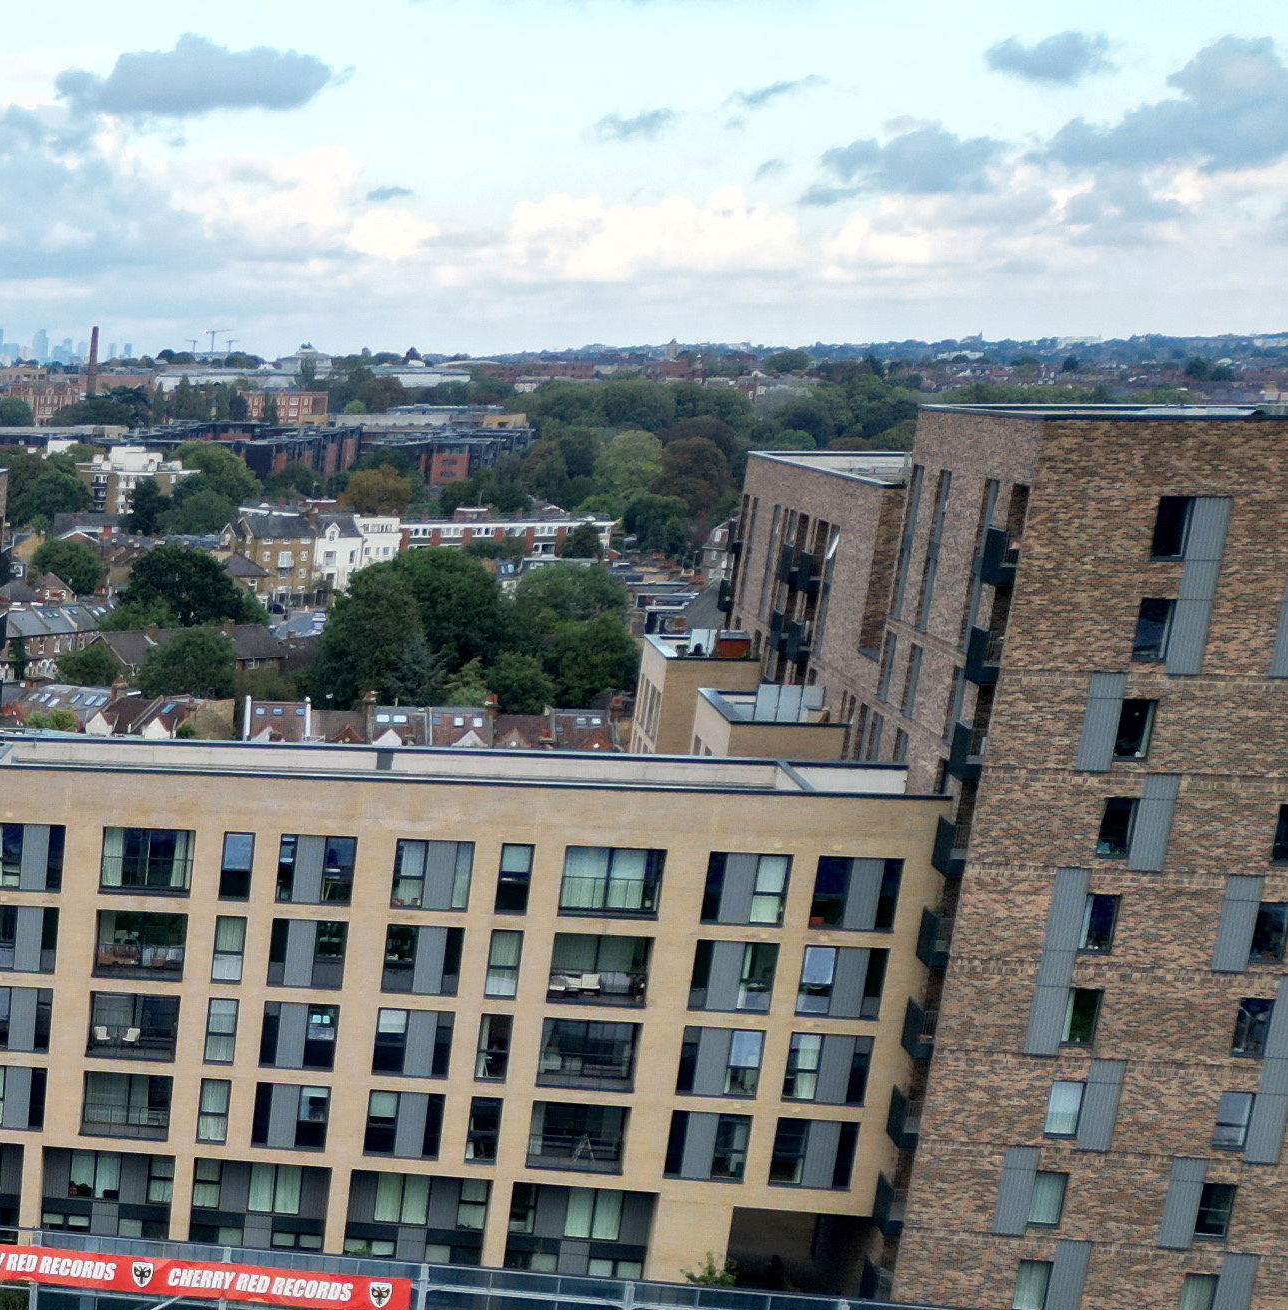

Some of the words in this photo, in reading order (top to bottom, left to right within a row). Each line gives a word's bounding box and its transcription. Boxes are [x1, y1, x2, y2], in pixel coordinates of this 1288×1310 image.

[6, 1253, 38, 1272] RED
[39, 1256, 117, 1281] RECORDS
[167, 1267, 236, 1290] CHERRY
[235, 1273, 271, 1294] RED
[272, 1276, 354, 1302] RECORDS
